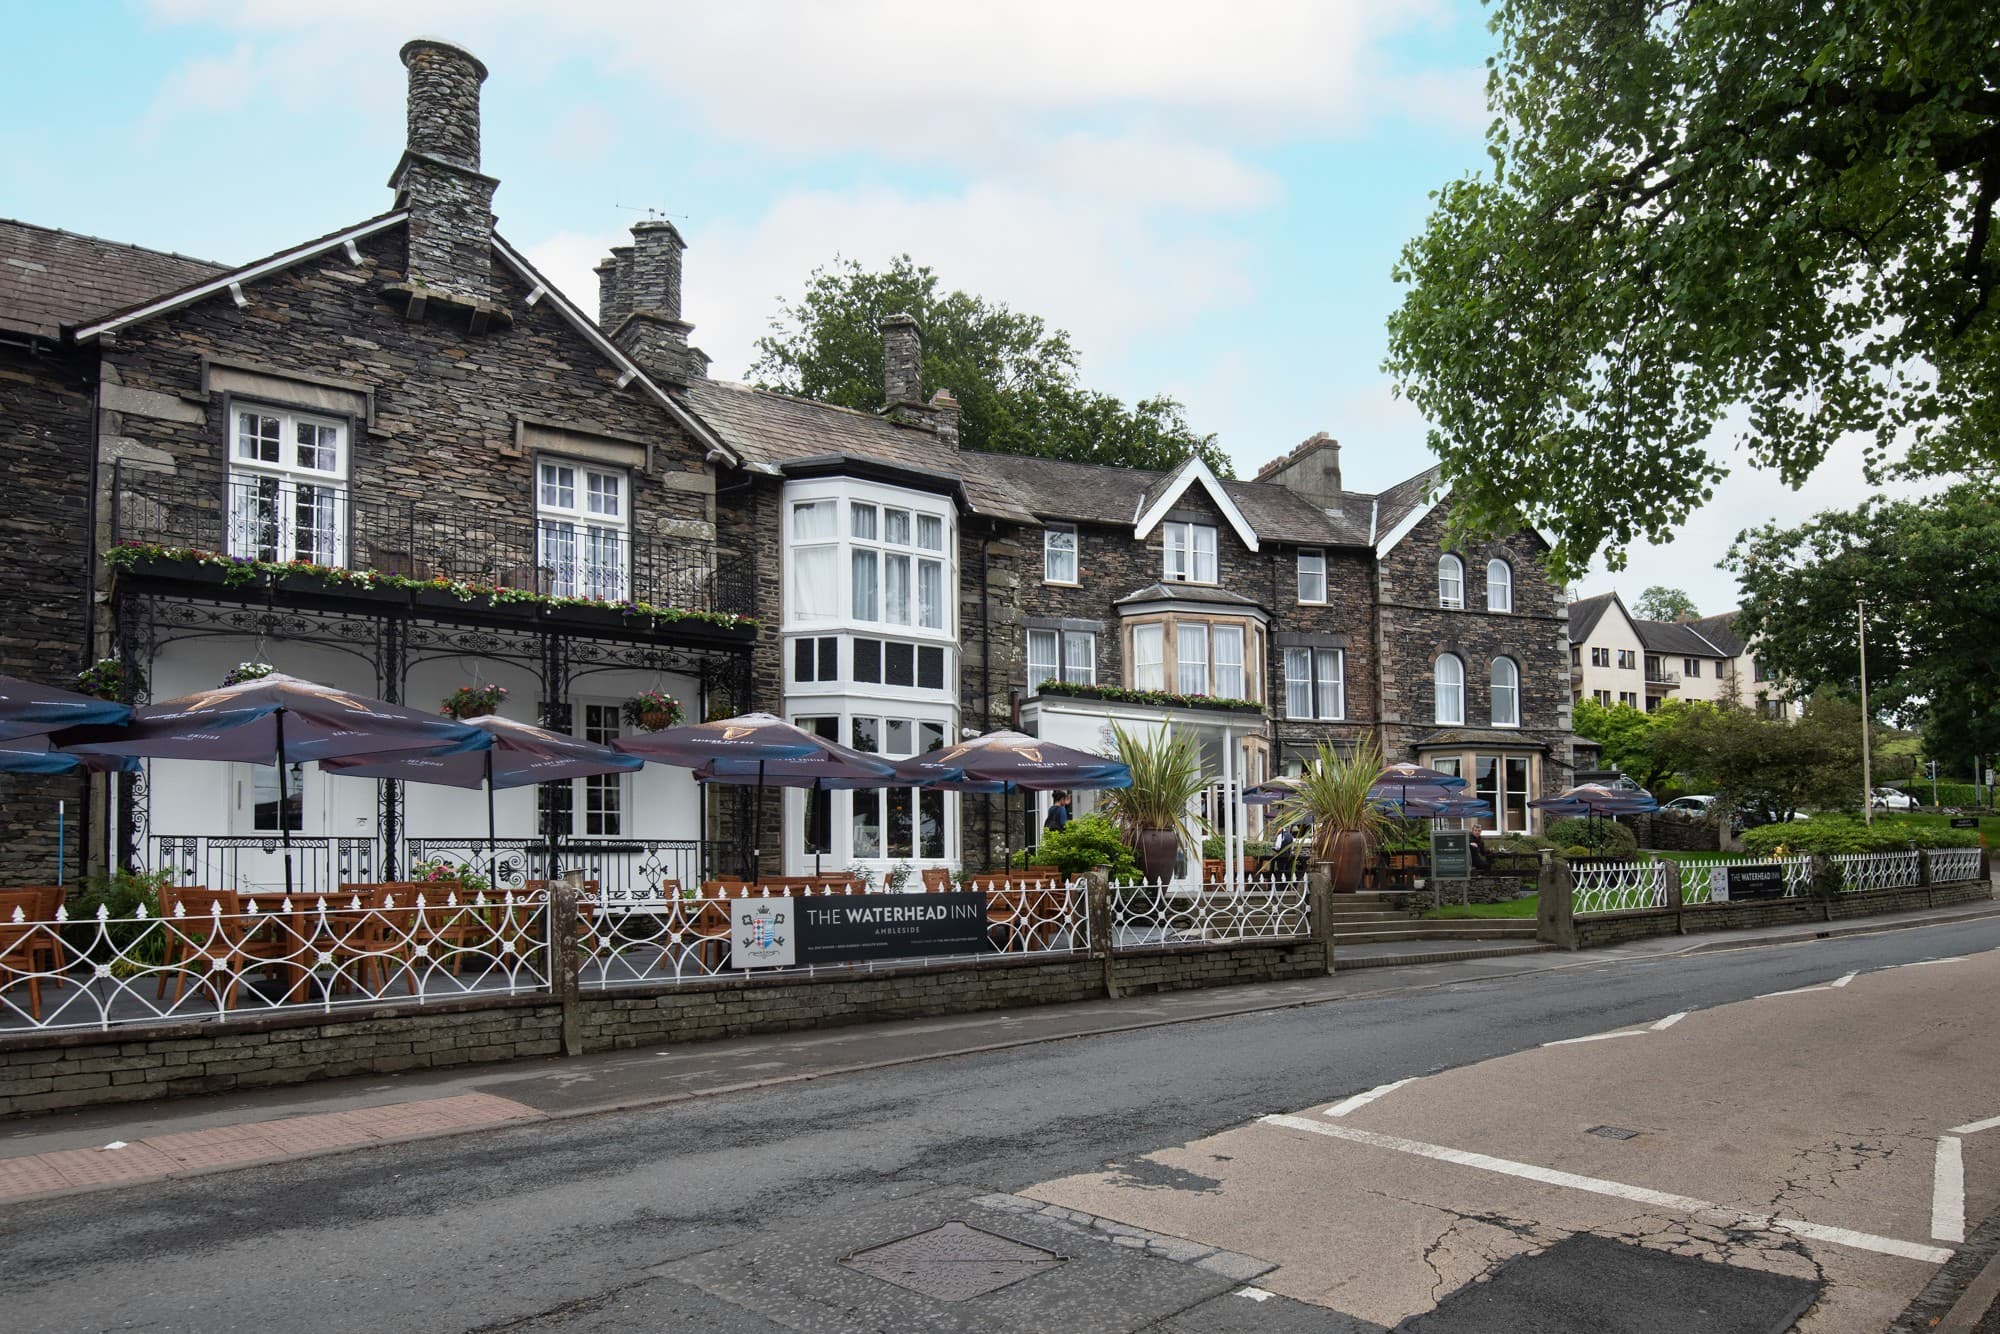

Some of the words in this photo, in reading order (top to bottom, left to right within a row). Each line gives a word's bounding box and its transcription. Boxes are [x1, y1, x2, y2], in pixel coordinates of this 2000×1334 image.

[1742, 871, 1770, 880] WATERHEAD
[807, 909, 841, 926] THE
[845, 905, 948, 924] WATERHEAD
[951, 904, 977, 920] INN
[875, 926, 920, 936] AMBLESIDE
